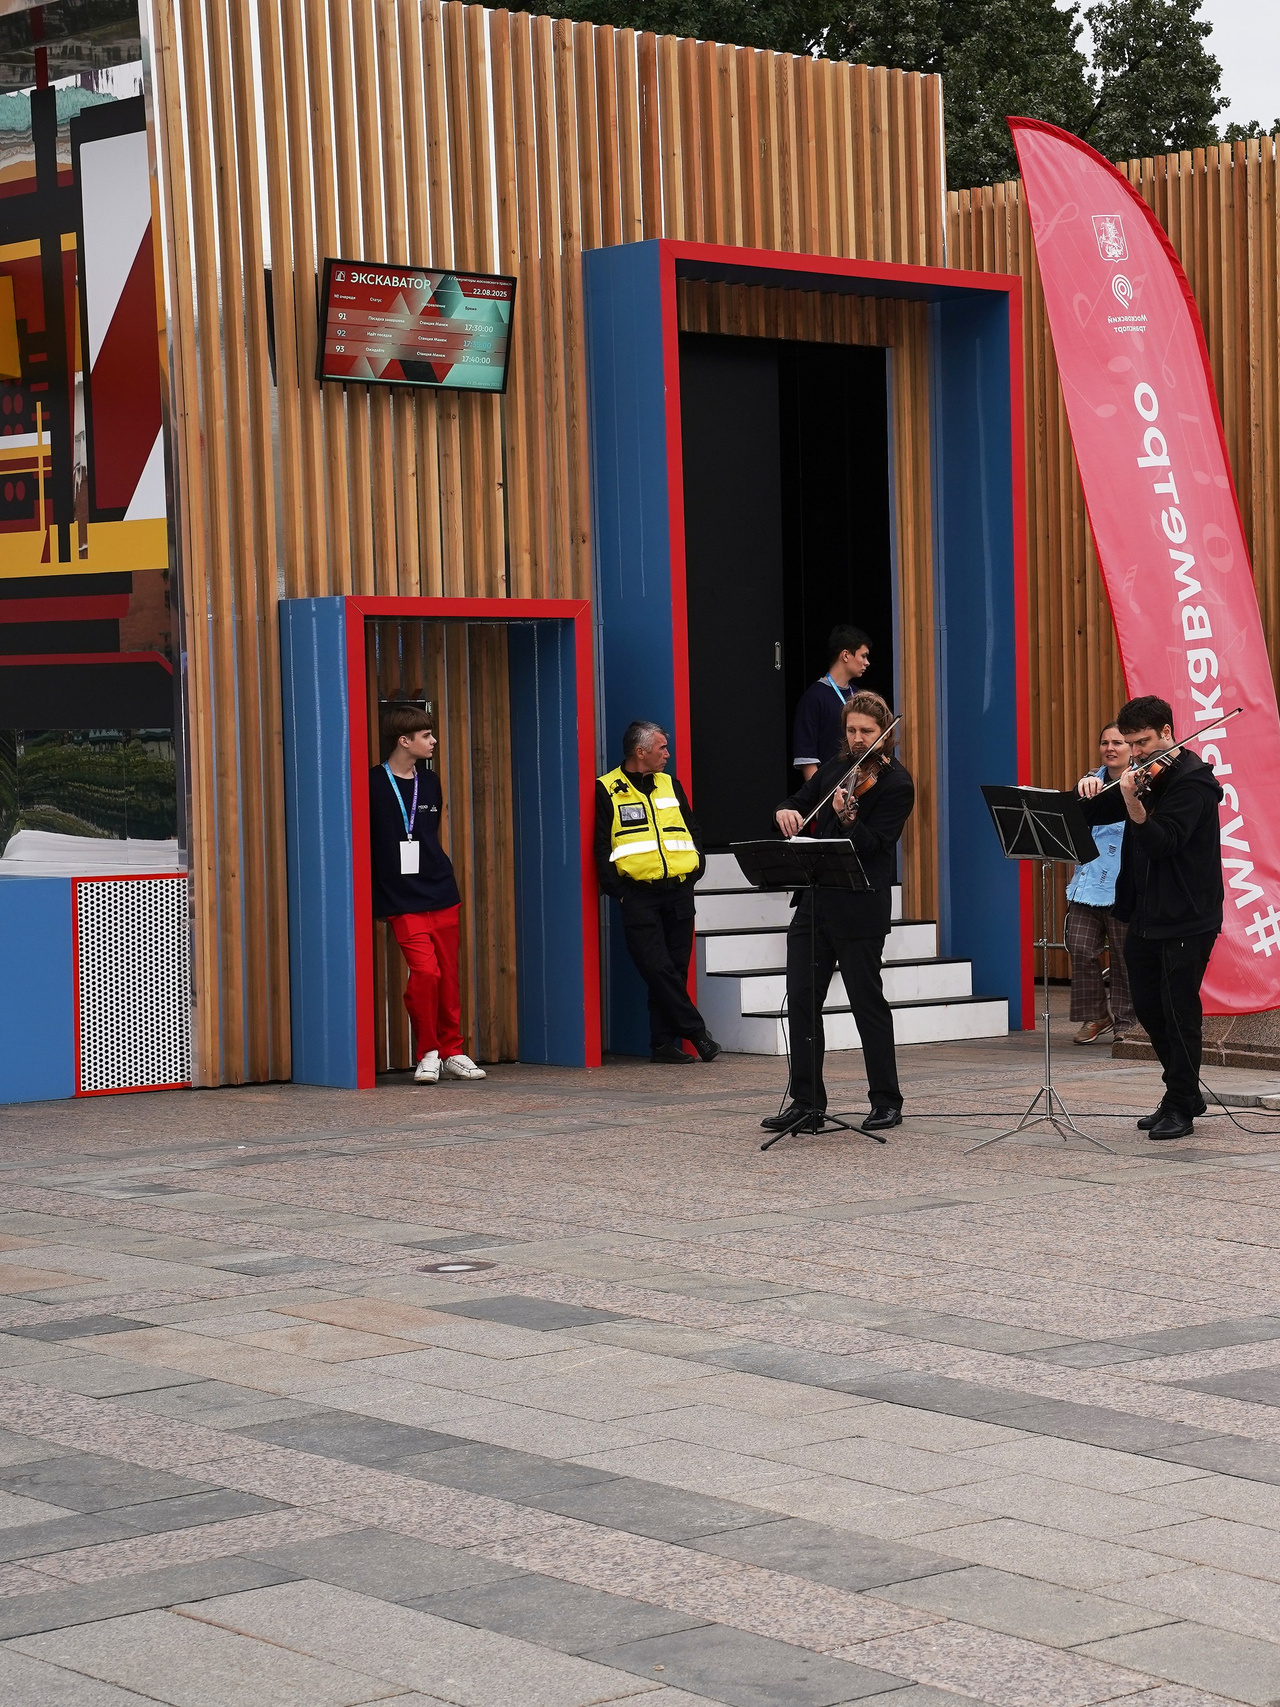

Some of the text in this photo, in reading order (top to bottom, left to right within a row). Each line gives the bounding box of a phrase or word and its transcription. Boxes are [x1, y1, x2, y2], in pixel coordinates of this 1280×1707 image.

[350, 271, 432, 290] ЭКСКАВАТОР
[472, 288, 508, 298] 22.08.2025
[338, 312, 347, 320] 91
[464, 323, 494, 333] 17:30:00
[336, 329, 346, 337] 92
[335, 345, 345, 353] 93
[463, 340, 492, 349] 17:35:00
[461, 355, 491, 365] 17:40:00
